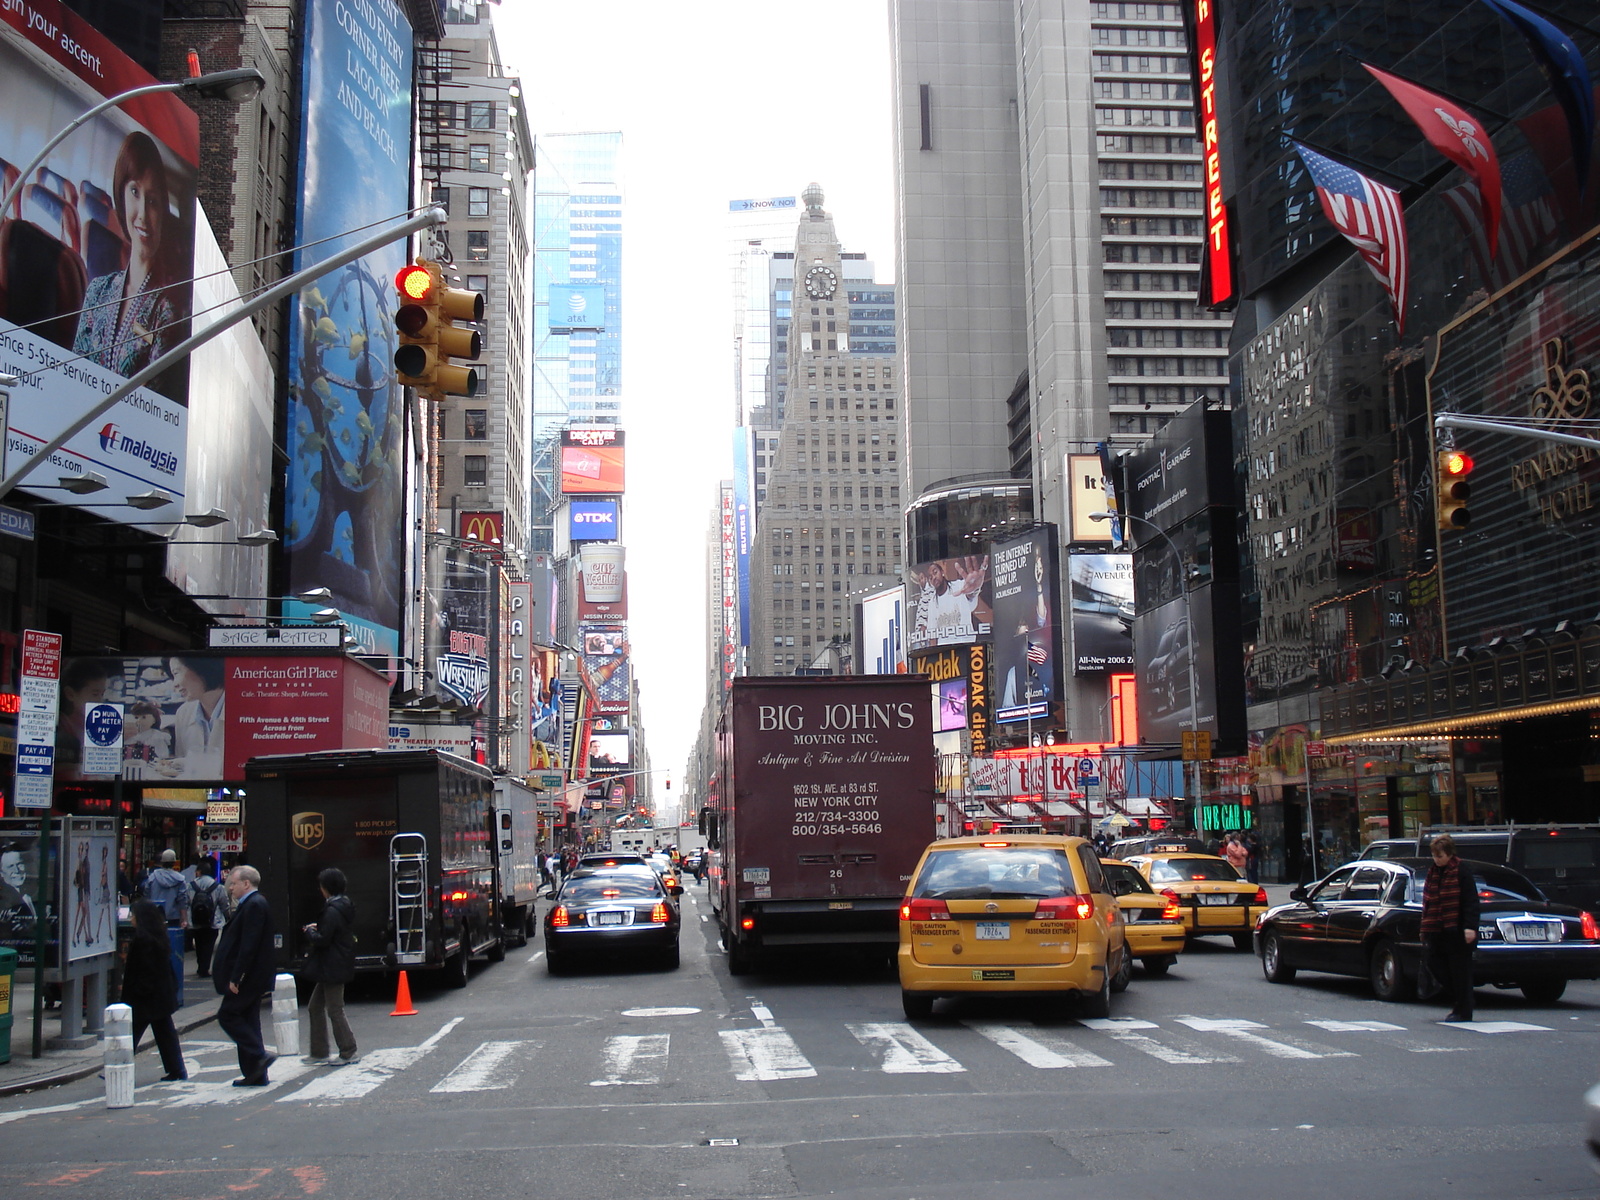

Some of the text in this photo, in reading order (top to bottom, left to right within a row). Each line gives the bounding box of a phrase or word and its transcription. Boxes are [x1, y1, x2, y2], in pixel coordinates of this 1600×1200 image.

[27, 6, 58, 41] your
[60, 33, 104, 78] ascent.
[376, 15, 404, 71] EVERY
[347, 48, 389, 121] LAGOON
[337, 80, 363, 122] AND
[1201, 48, 1224, 252] STREET
[567, 314, 587, 323] at&t
[28, 342, 61, 373] 5-Star
[63, 362, 98, 390] service
[101, 380, 112, 395] to
[164, 408, 179, 427] and
[569, 431, 616, 440] DISCOVER
[120, 435, 178, 470] malaysia
[1137, 446, 1191, 492] PONTIAC GARAGE
[1540, 481, 1593, 525] HOTEL
[0, 511, 31, 531] EDIA
[583, 512, 613, 523] TDK
[738, 513, 747, 555] REUTERS
[994, 541, 1033, 565] THE INTERNET
[591, 562, 615, 575] CUP
[994, 556, 1027, 576] TURNED UP.
[994, 571, 1018, 588] WAY UP.
[1093, 571, 1126, 580] AVENUE
[27, 633, 59, 645] NO STANDING
[220, 631, 261, 645] SAGE
[910, 622, 992, 645] SOUTHPOLE
[916, 649, 961, 681] Kodak
[1078, 656, 1106, 664] All-New
[1107, 656, 1126, 664] 2006
[232, 666, 338, 680] American Girl Place
[970, 645, 985, 708] KODAK
[256, 690, 280, 698] Theater.
[280, 690, 300, 699] Shops.
[300, 690, 329, 698] Memories.
[257, 716, 282, 724] Avenue
[290, 716, 306, 724] 49th
[307, 716, 330, 724] Street
[758, 702, 915, 731] BIG JOHN'S
[793, 733, 879, 745] MOVING INC.
[25, 746, 47, 755] PAY AT
[21, 756, 50, 764] MUNI-METER
[757, 749, 911, 770] Antique & Fine Art Division
[793, 784, 809, 795] 1602
[824, 783, 839, 794] AVE.
[840, 783, 847, 793] at
[848, 783, 858, 793] 83
[859, 782, 866, 792] rd
[868, 782, 879, 793] ST.
[794, 795, 878, 808] NEW YORK CITY
[795, 810, 879, 823] 212/734-3300
[359, 820, 371, 828] 800
[791, 823, 882, 836] 800/354-5646
[294, 823, 323, 845] ups
[355, 828, 398, 837] www.ups.com
[829, 869, 843, 878] 26
